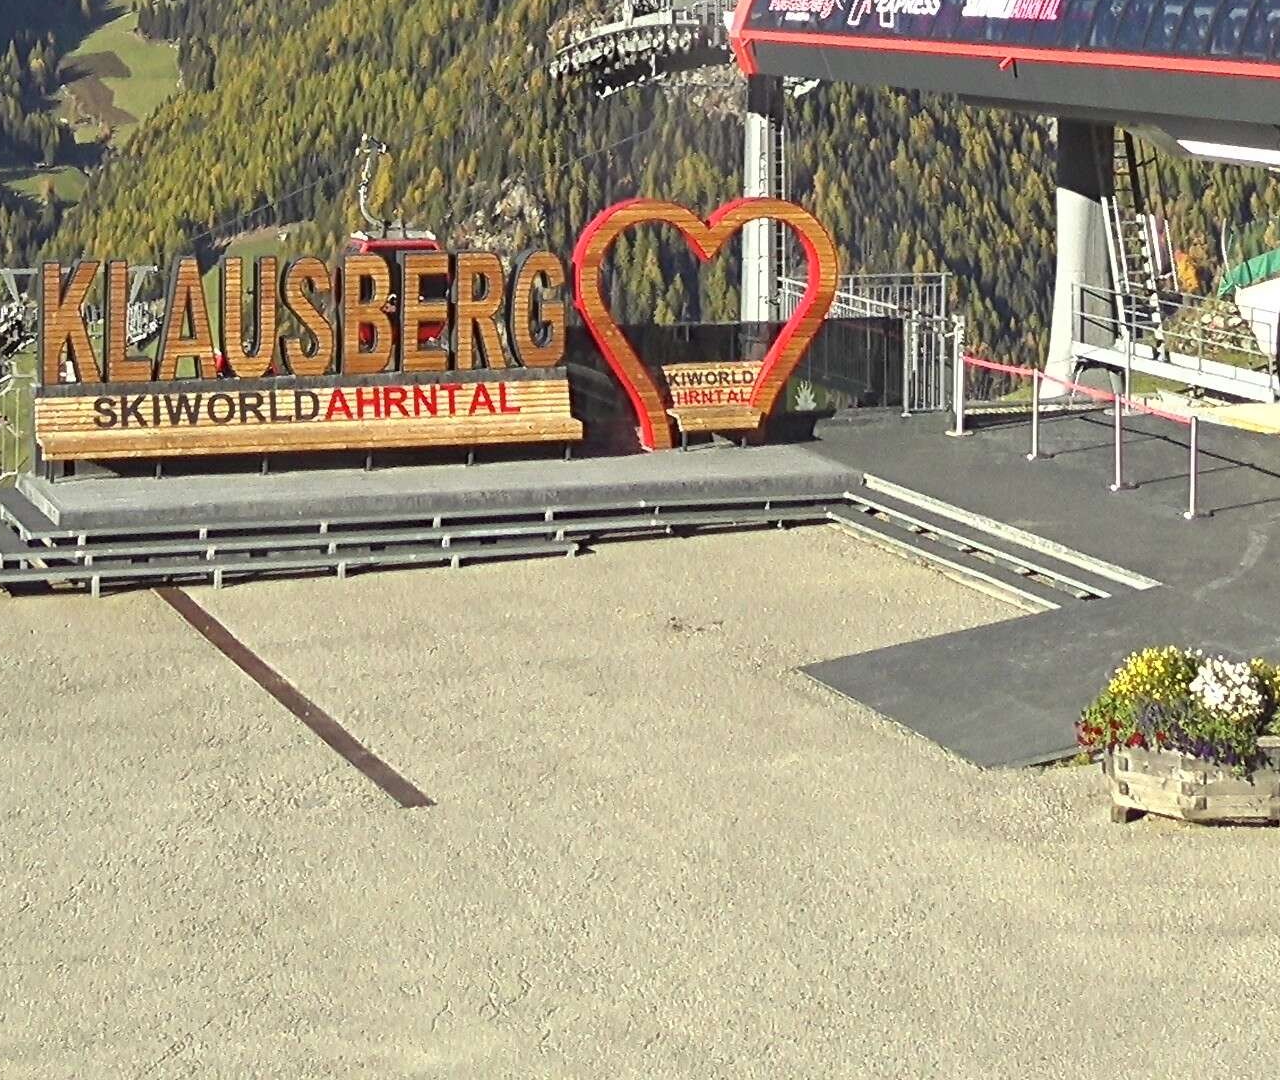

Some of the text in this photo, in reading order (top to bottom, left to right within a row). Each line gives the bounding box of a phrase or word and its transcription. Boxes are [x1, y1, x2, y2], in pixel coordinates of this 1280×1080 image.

[42, 250, 567, 385] KLAUSBERG
[668, 370, 754, 387] KIWORLD
[676, 388, 751, 406] HRNTAL
